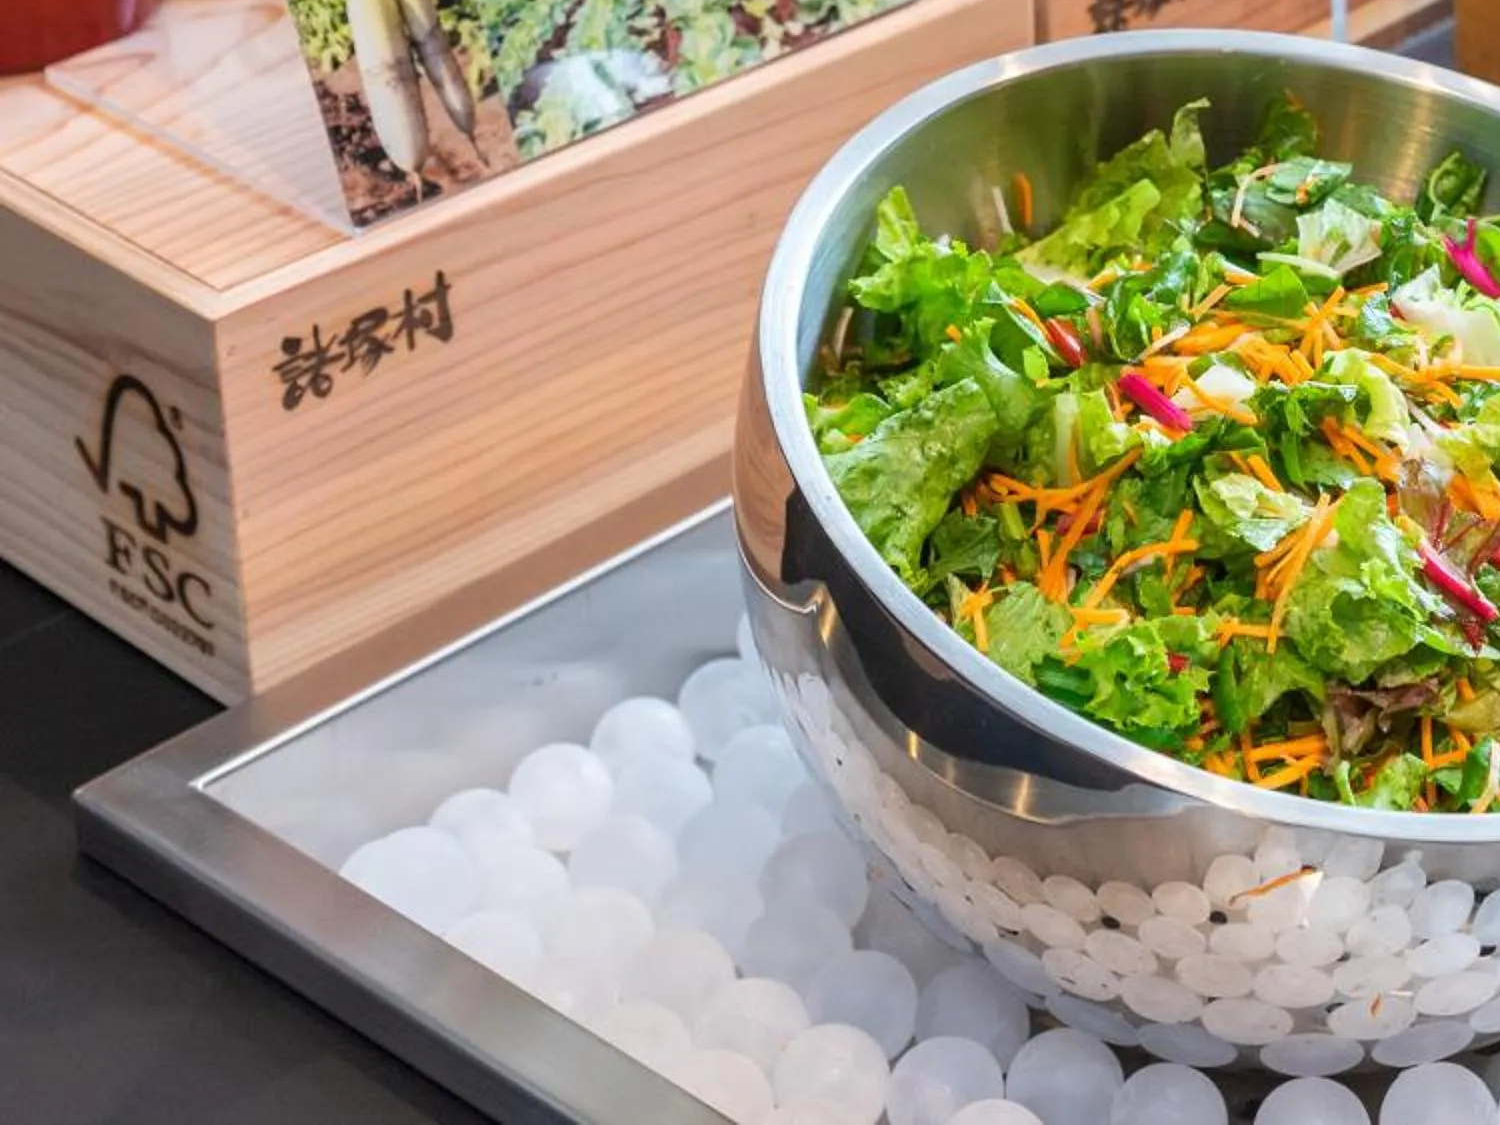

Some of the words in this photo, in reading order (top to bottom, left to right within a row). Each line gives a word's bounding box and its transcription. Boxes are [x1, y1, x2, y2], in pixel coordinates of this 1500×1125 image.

[272, 270, 456, 411] 諸塚村
[100, 516, 216, 630] FSC
